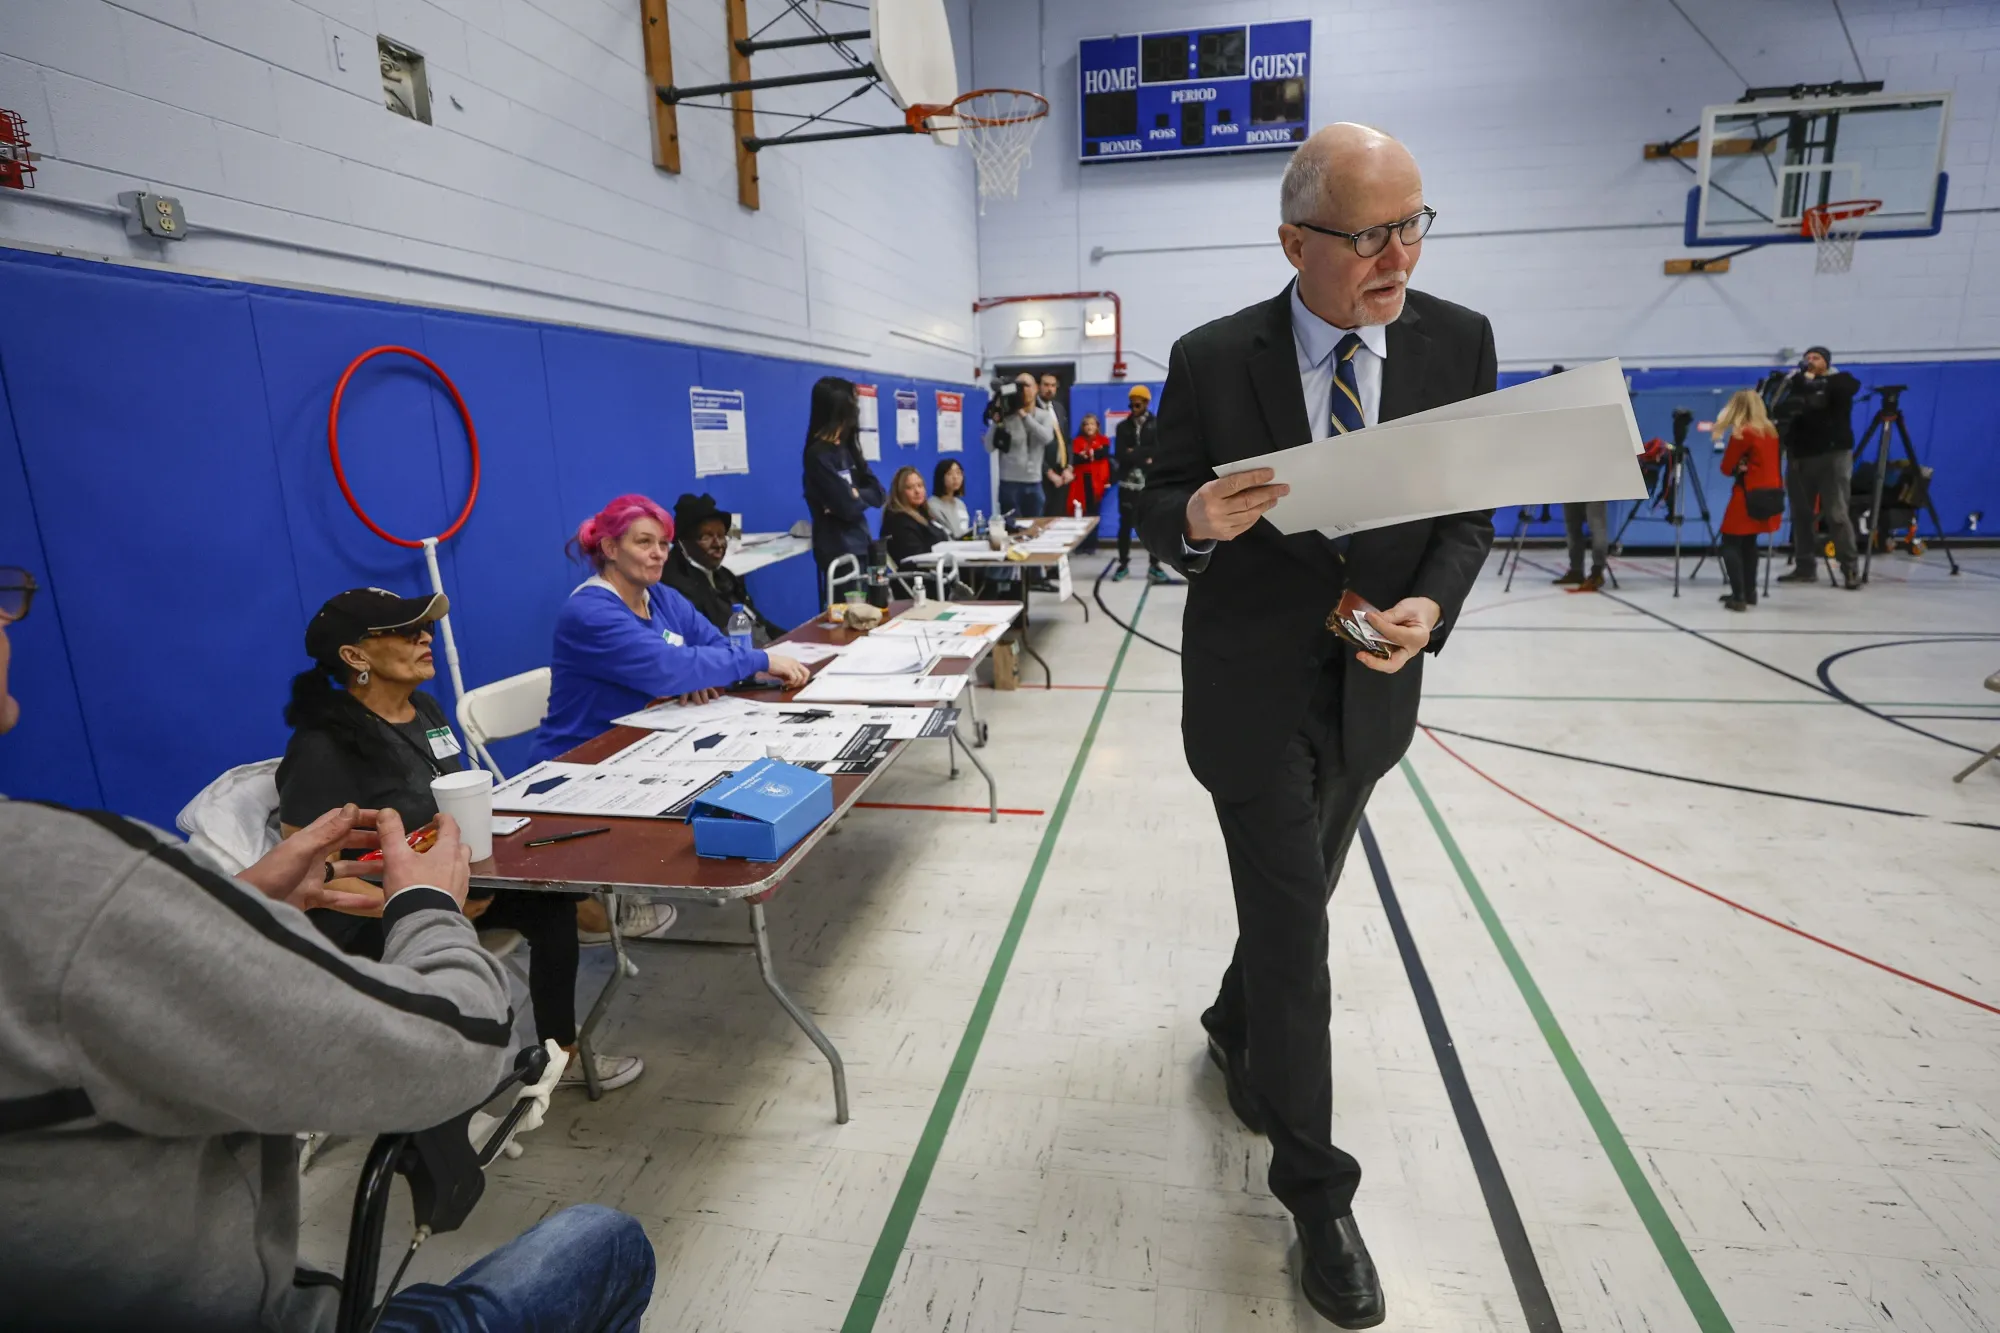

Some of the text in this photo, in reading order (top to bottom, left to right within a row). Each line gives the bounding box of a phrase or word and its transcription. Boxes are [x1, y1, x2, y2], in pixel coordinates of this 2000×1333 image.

[1251, 53, 1307, 80] GUEST
[1085, 67, 1137, 94] HOME
[1171, 88, 1217, 104] PERIOD
[1149, 128, 1177, 140] POSS
[1211, 123, 1239, 136] POSS
[1246, 128, 1291, 144] BONUS
[1100, 139, 1142, 154] BONUS
